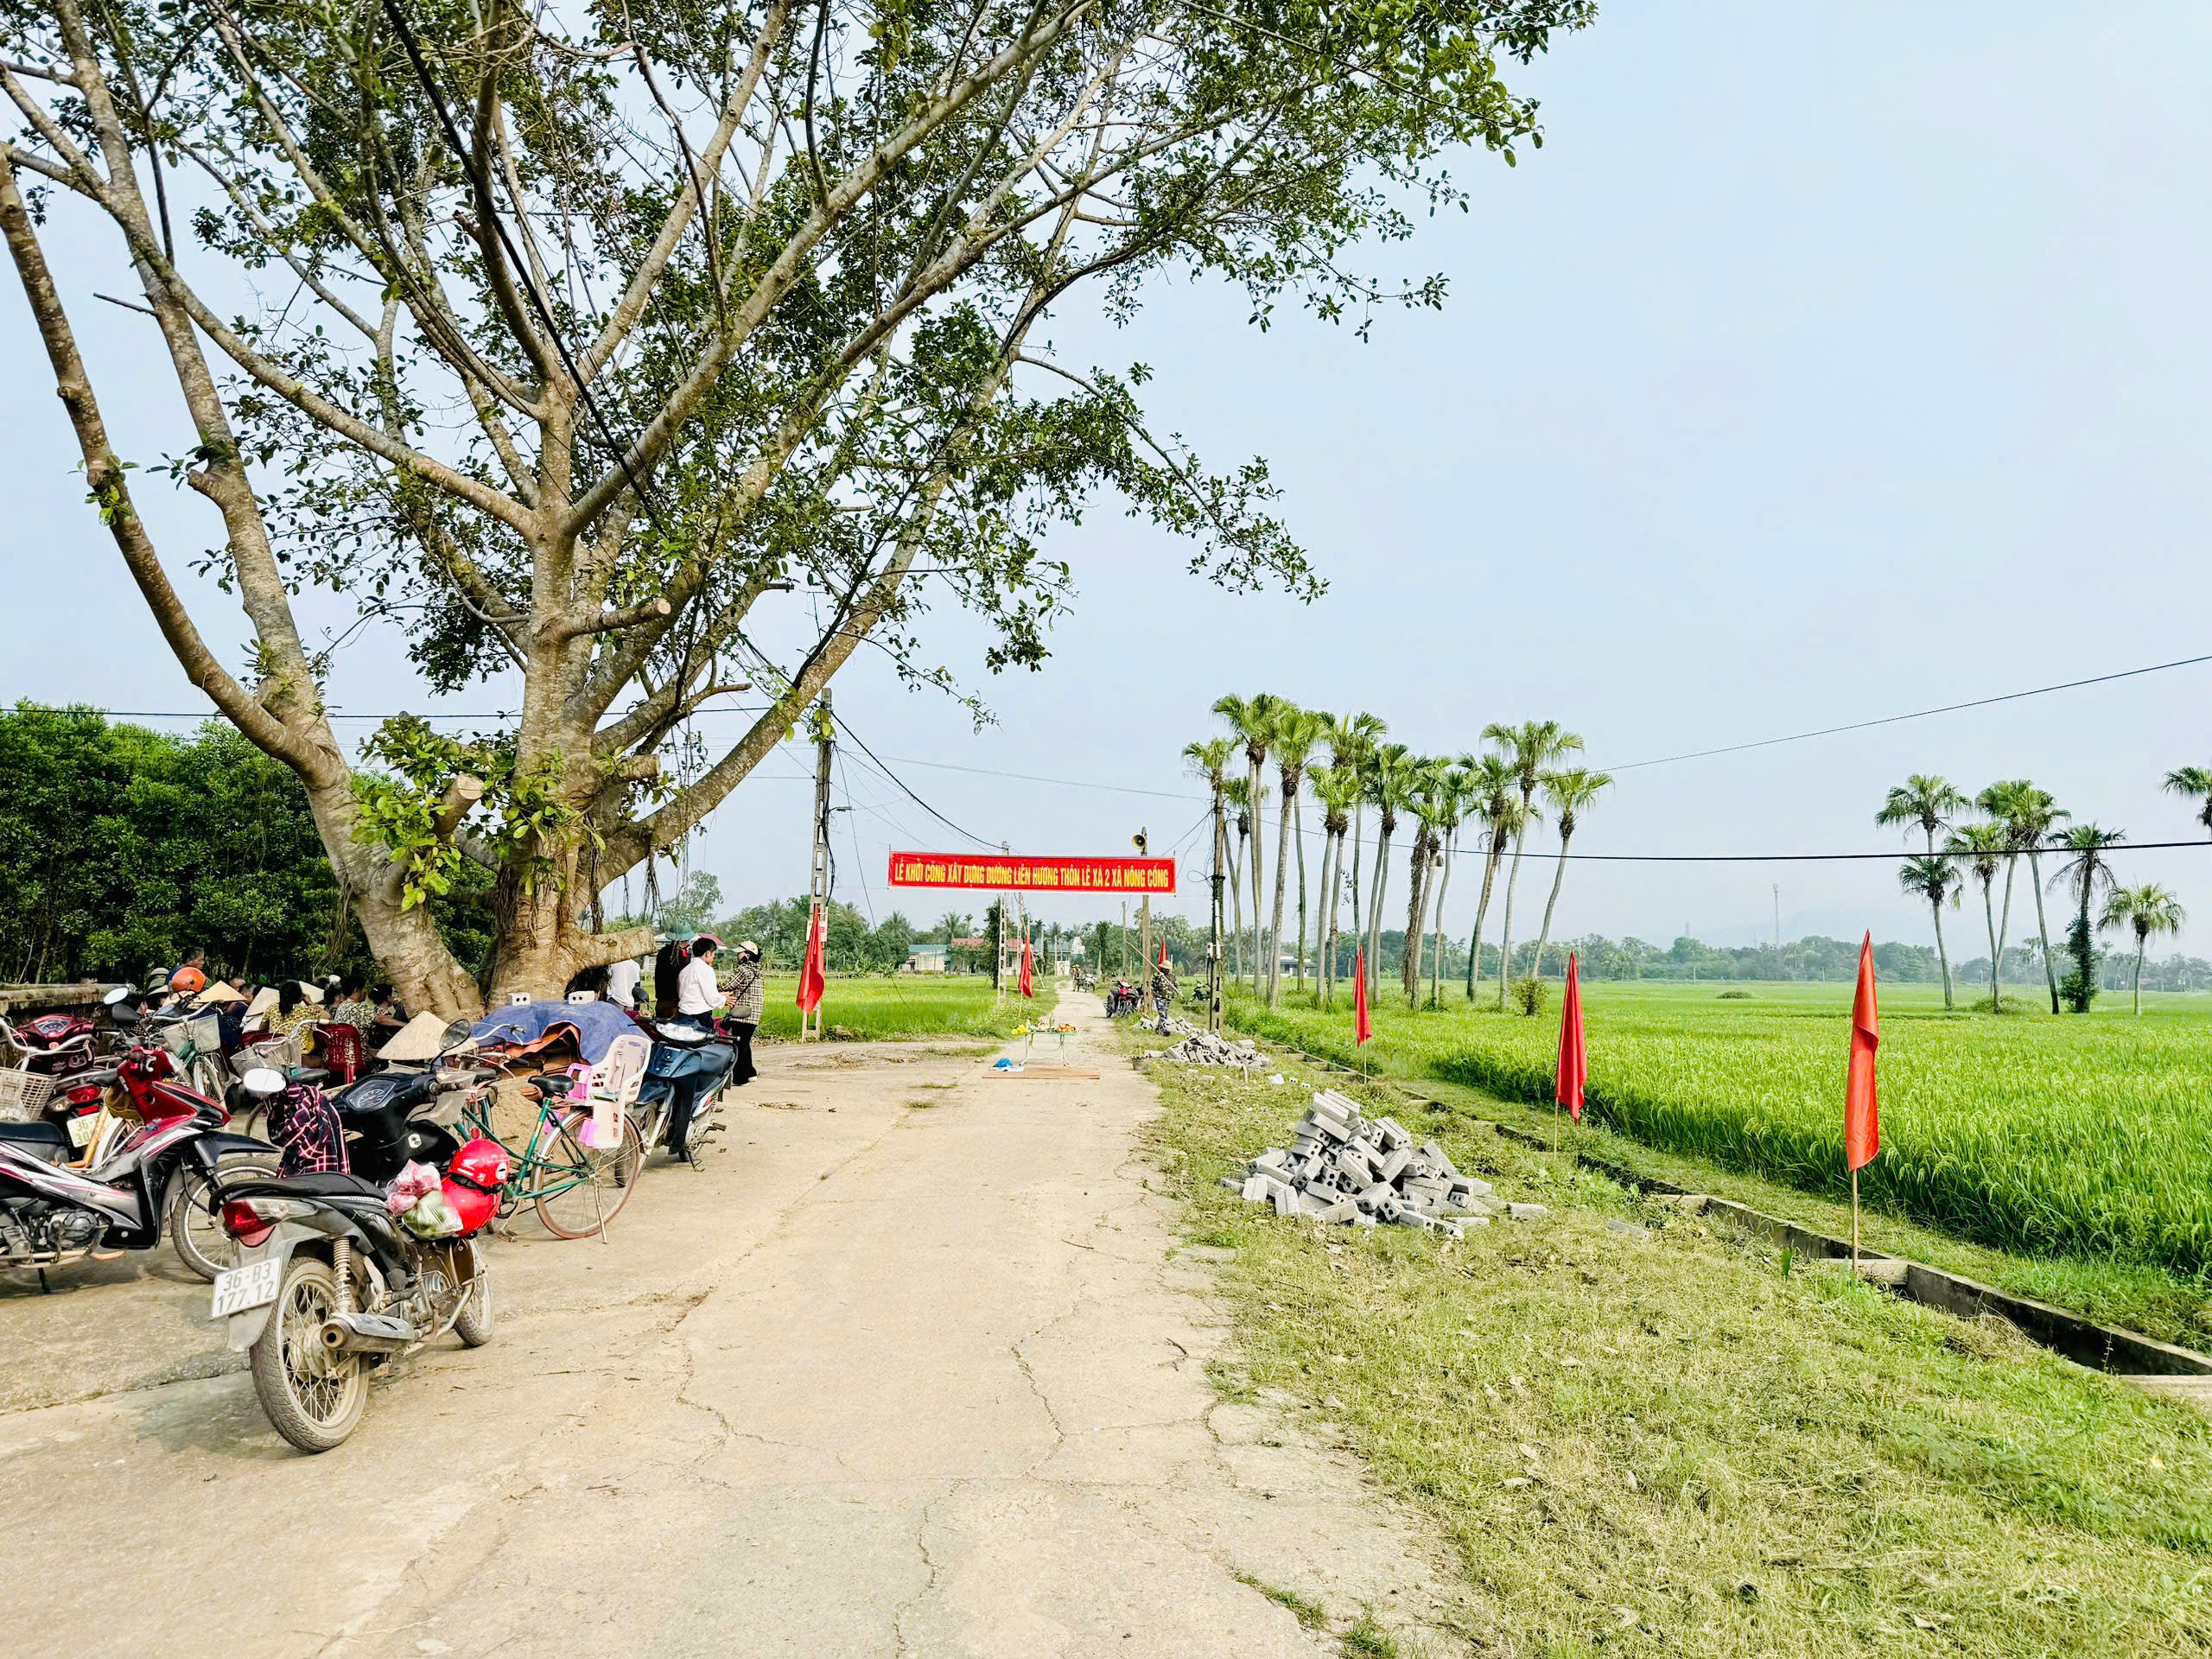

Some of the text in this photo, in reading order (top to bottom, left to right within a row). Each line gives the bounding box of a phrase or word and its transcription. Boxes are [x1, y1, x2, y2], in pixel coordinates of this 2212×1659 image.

[925, 861, 945, 882] CÔNG
[947, 861, 963, 883] XÂY
[1014, 864, 1030, 885] LIÊN
[1060, 864, 1080, 887] THÔN
[1105, 868, 1110, 887] 2
[1123, 865, 1146, 887] NÔNG
[1147, 862, 1169, 887] CỐNG
